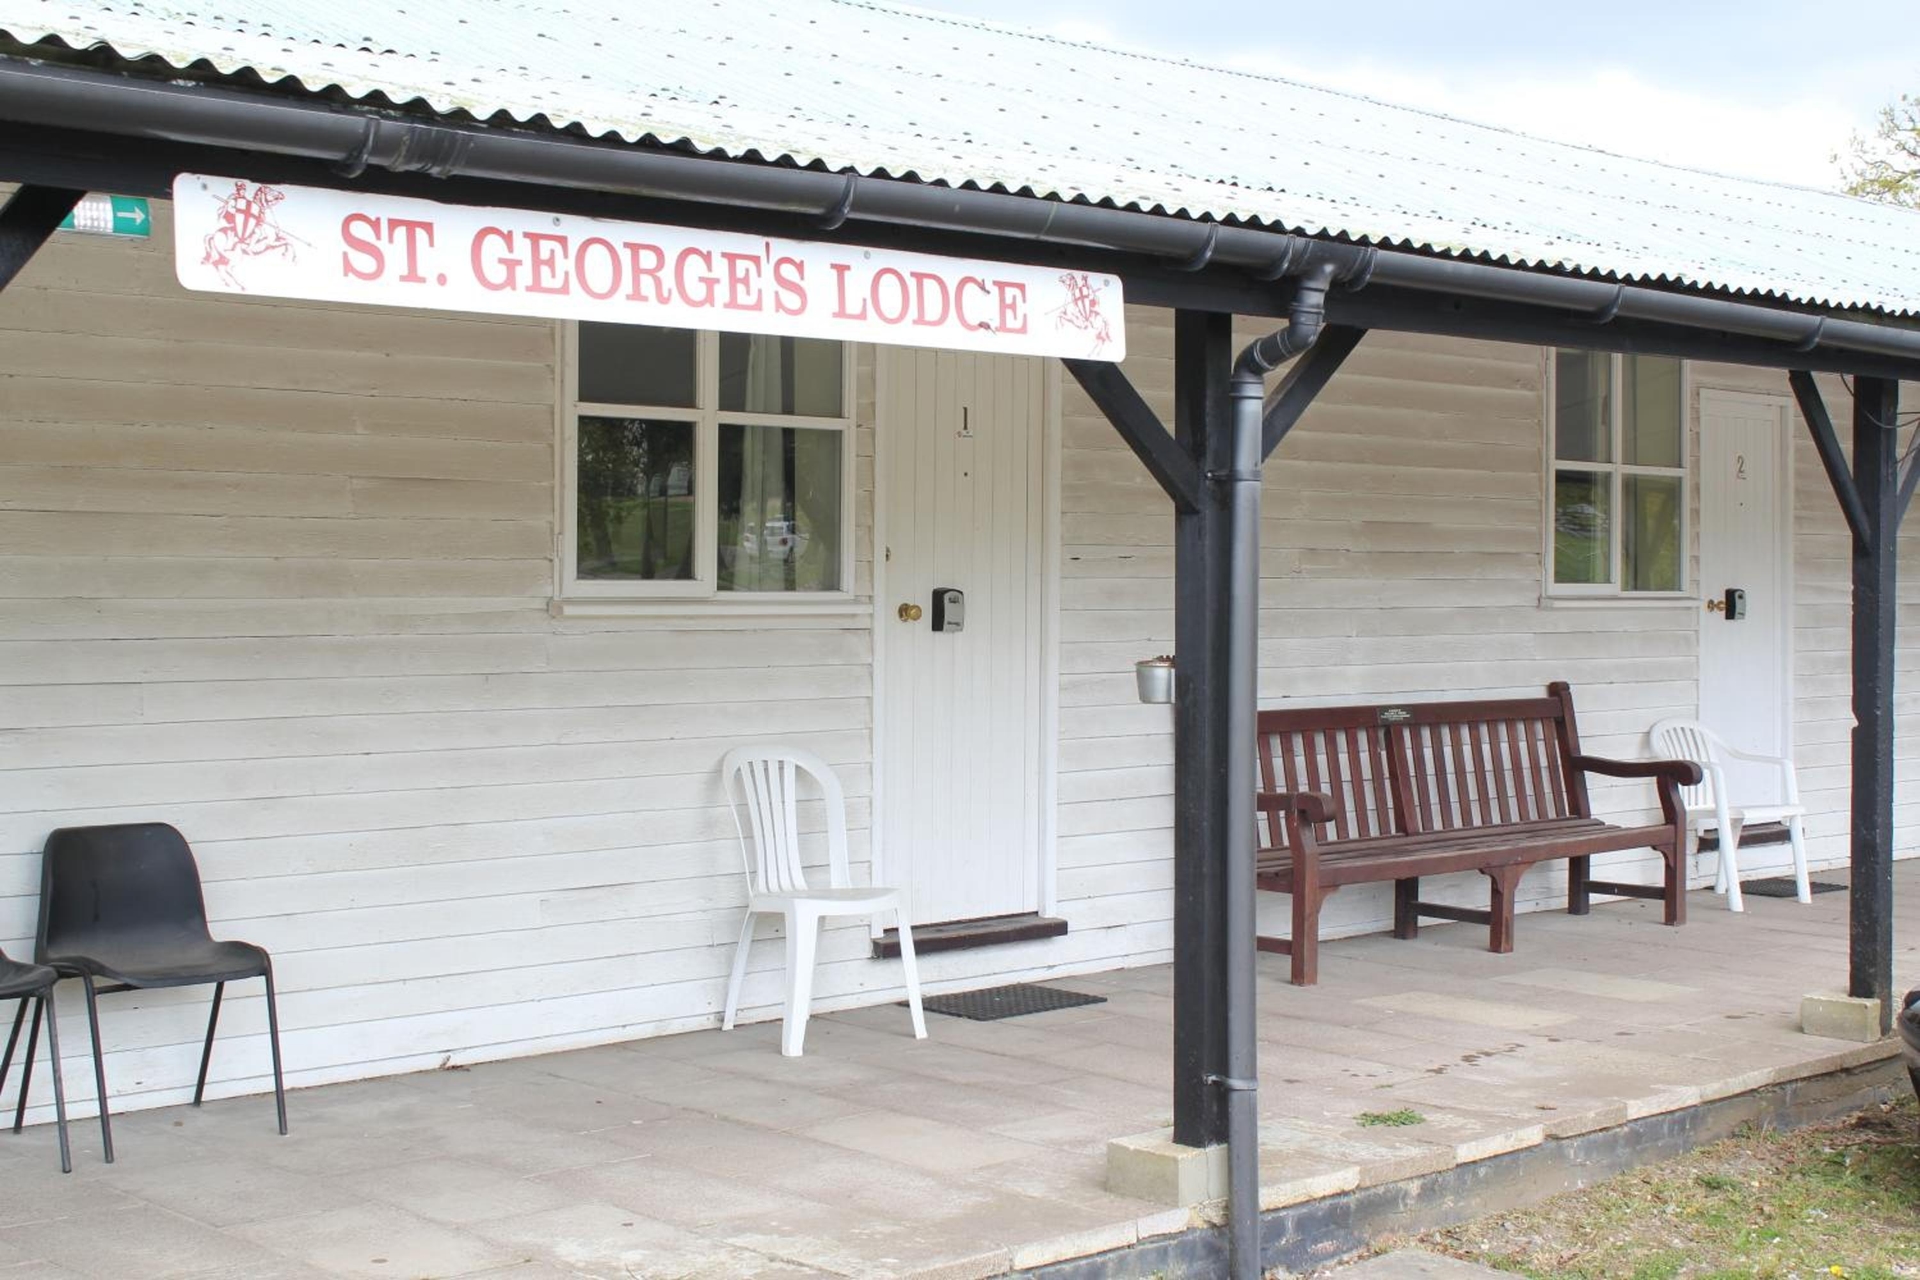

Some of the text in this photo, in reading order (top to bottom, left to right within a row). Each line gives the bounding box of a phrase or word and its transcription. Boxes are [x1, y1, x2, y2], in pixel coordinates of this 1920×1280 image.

[341, 212, 448, 287] ST.
[470, 226, 808, 316] GEORGE'S
[962, 406, 968, 431] 1
[1737, 455, 1745, 474] 2
